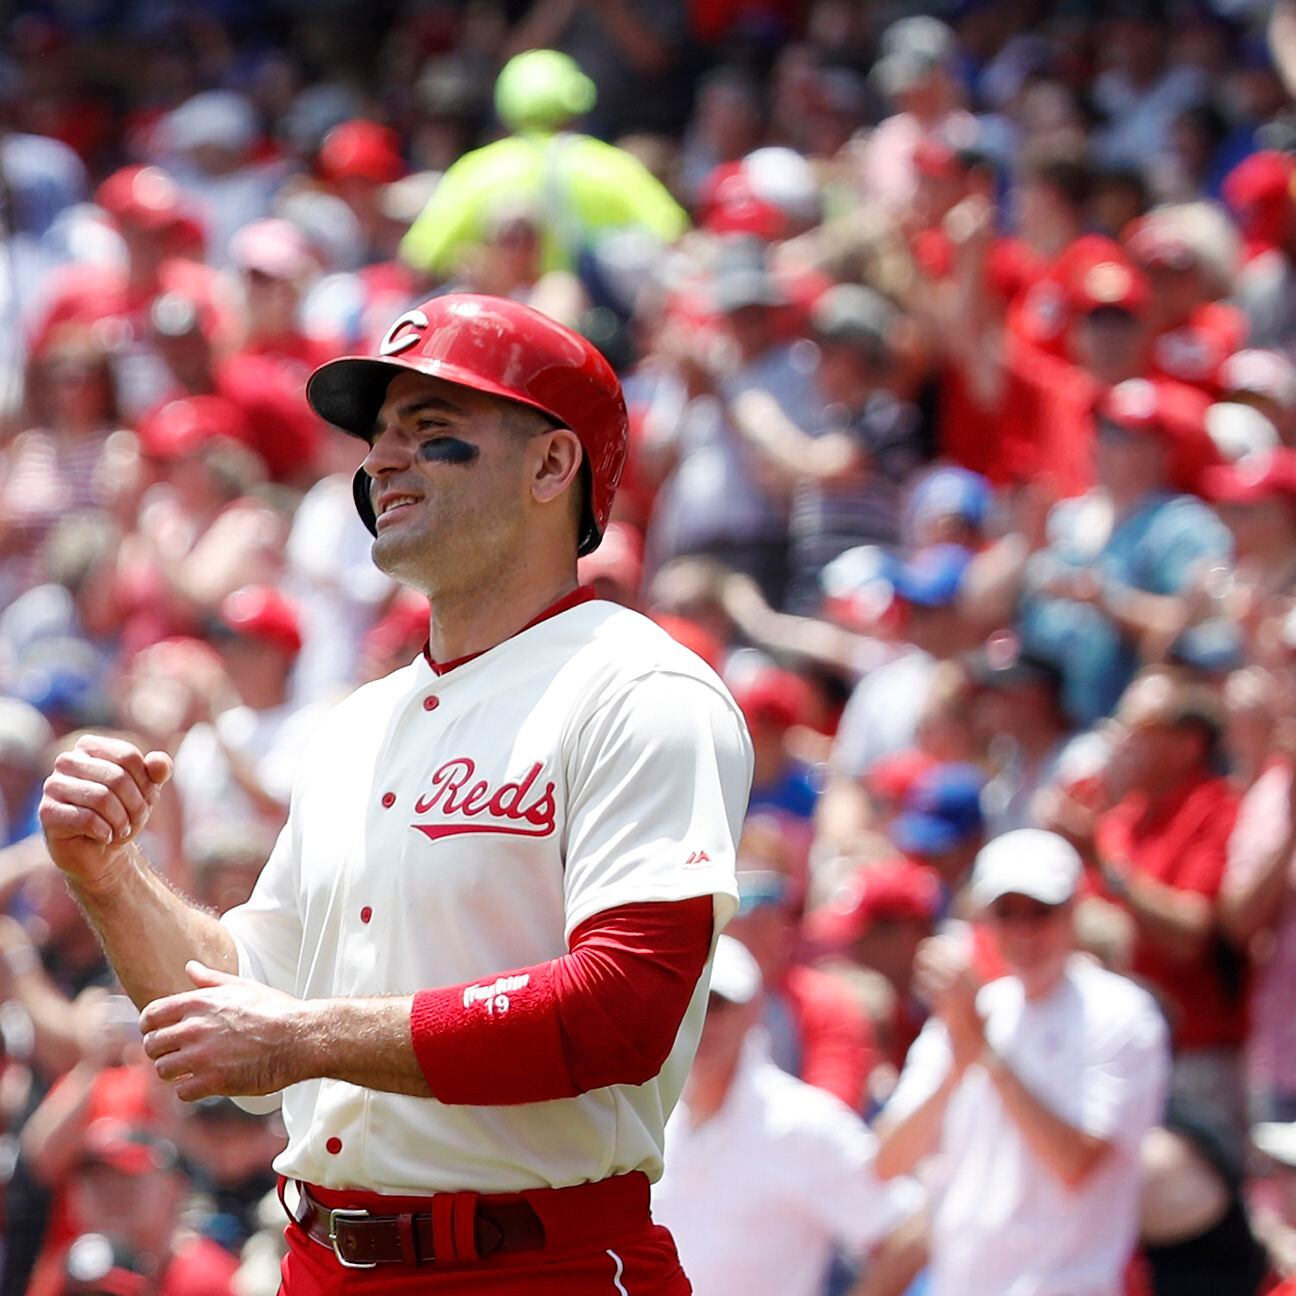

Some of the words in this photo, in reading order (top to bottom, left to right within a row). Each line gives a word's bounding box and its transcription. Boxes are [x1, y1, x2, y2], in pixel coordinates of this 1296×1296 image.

[379, 309, 428, 356] C
[411, 757, 556, 841] Reds
[484, 994, 510, 1015] 19
